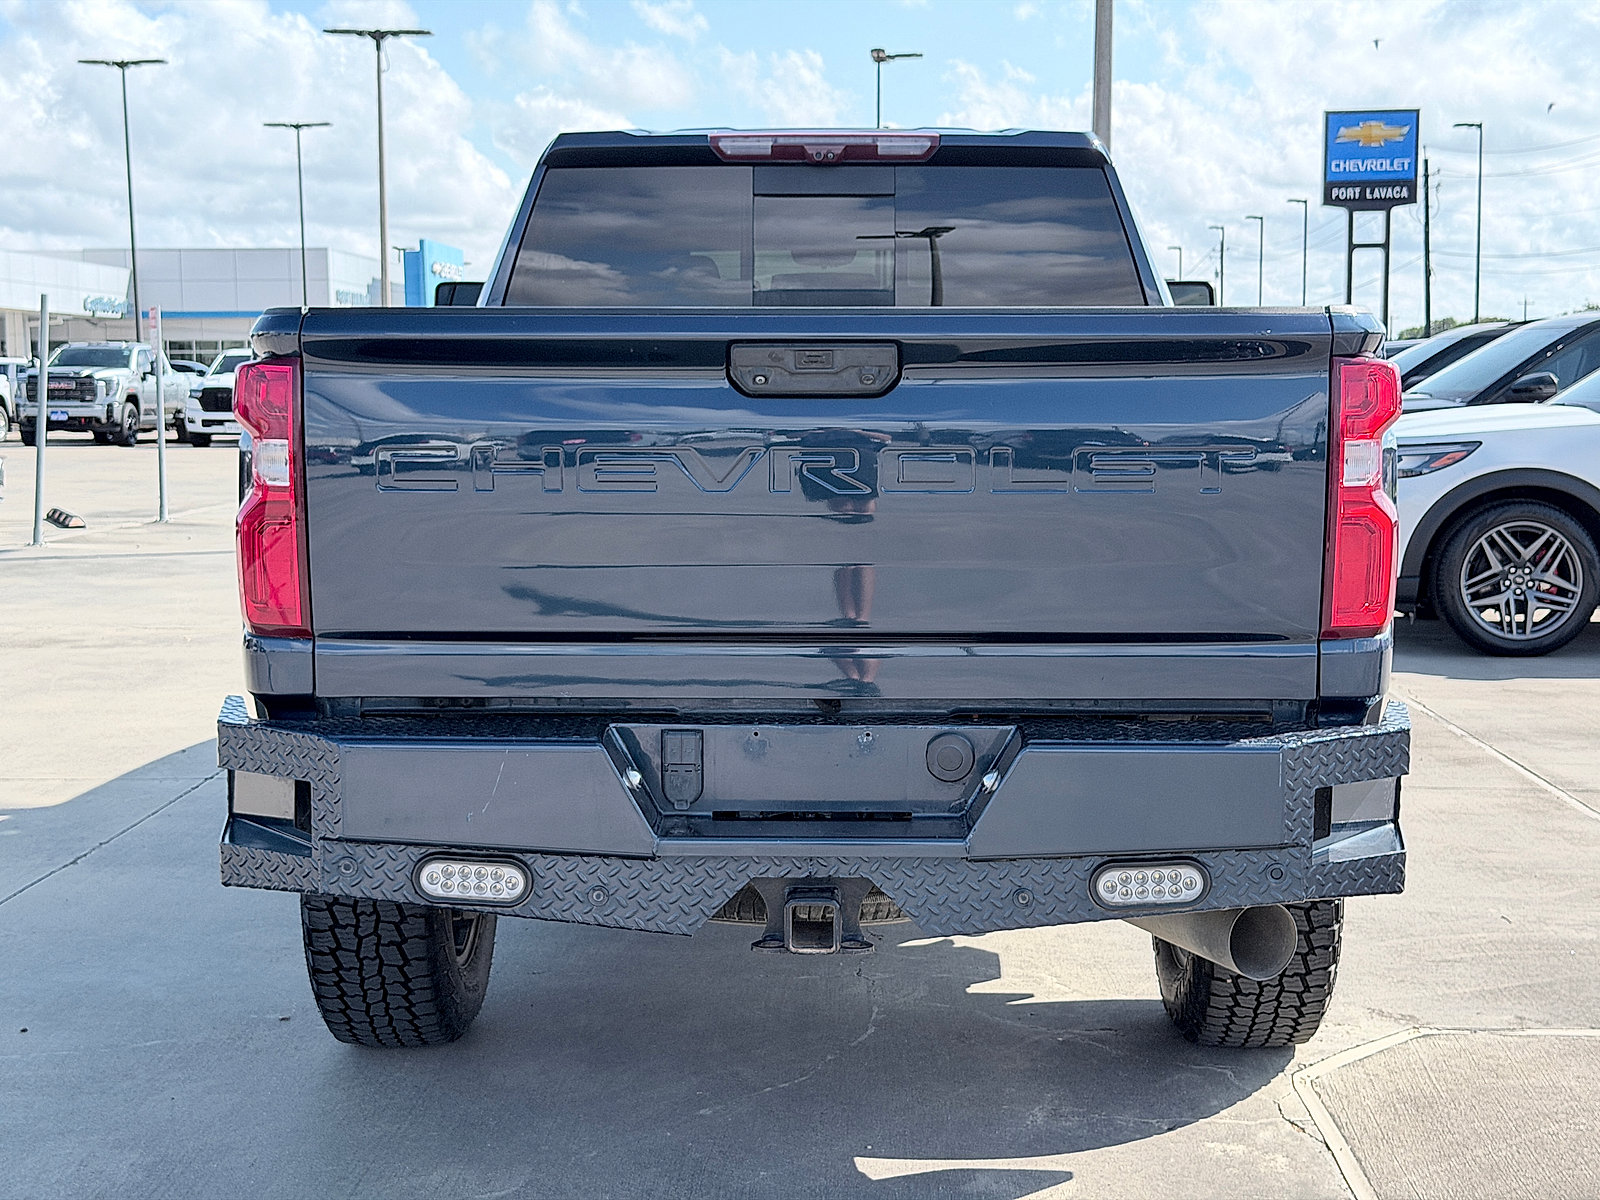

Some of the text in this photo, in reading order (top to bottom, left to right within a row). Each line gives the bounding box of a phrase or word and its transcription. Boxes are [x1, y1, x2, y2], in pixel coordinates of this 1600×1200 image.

[1331, 158, 1411, 172] CHEVROLET
[1331, 186, 1408, 200] PORT LAVACA
[375, 444, 1258, 494] CHEVROLET
